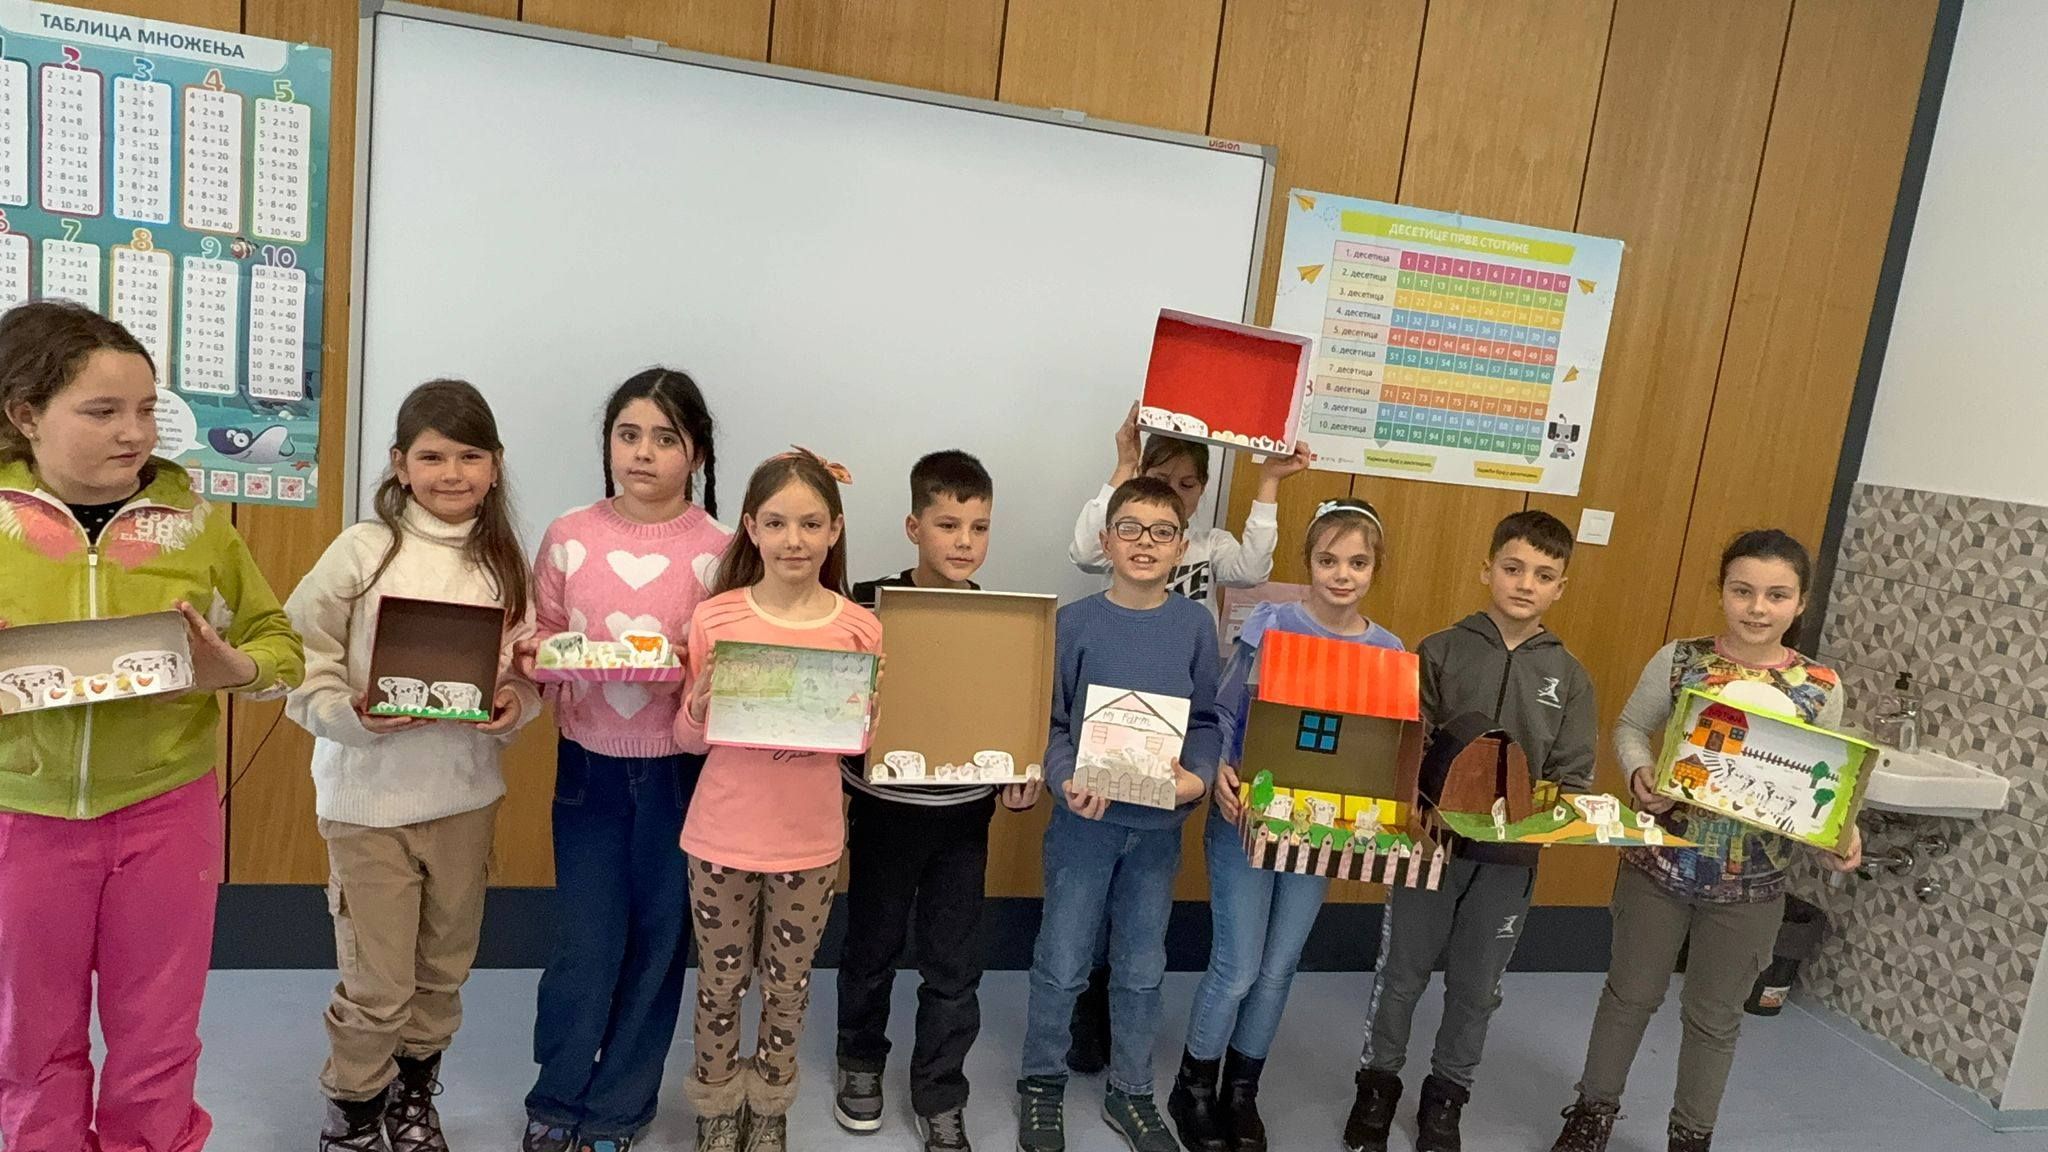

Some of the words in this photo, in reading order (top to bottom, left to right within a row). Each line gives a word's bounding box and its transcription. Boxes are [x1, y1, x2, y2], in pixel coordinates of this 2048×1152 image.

[40, 13, 132, 42] ТАБЛИЦА
[138, 29, 245, 59] МНОЖЕЊА
[62, 45, 81, 70] 2
[133, 56, 154, 82] 3
[203, 68, 225, 92] 4
[273, 79, 295, 103] 5
[219, 125, 229, 133] 12
[289, 121, 299, 129] 10
[148, 128, 159, 136] 12
[77, 146, 87, 154] 12
[288, 148, 299, 156] 20
[218, 152, 229, 160] 20
[77, 160, 87, 168] 14
[148, 170, 158, 178] 21
[218, 166, 229, 174] 24
[77, 175, 88, 183] 16
[147, 184, 159, 192] 24
[286, 203, 297, 211] 40
[61, 218, 82, 242] 7
[131, 228, 153, 252] 8
[1389, 224, 1450, 241] ДЕСЕТИЦЕ
[1450, 232, 1479, 245] ПРВЕ
[1480, 237, 1530, 254] СТОТИНЕ
[201, 236, 221, 260] 9
[262, 245, 296, 269] 10
[1353, 251, 1390, 263] десетица
[1350, 270, 1387, 281] десетица
[1348, 290, 1384, 301] десетица
[1344, 309, 1381, 320] десетица
[1341, 328, 1378, 339] десетица
[1339, 347, 1376, 358] десетица
[1336, 366, 1373, 377] десетица
[1334, 385, 1370, 395] десетица
[1331, 404, 1367, 414] десетица
[1330, 423, 1366, 433] десетица
